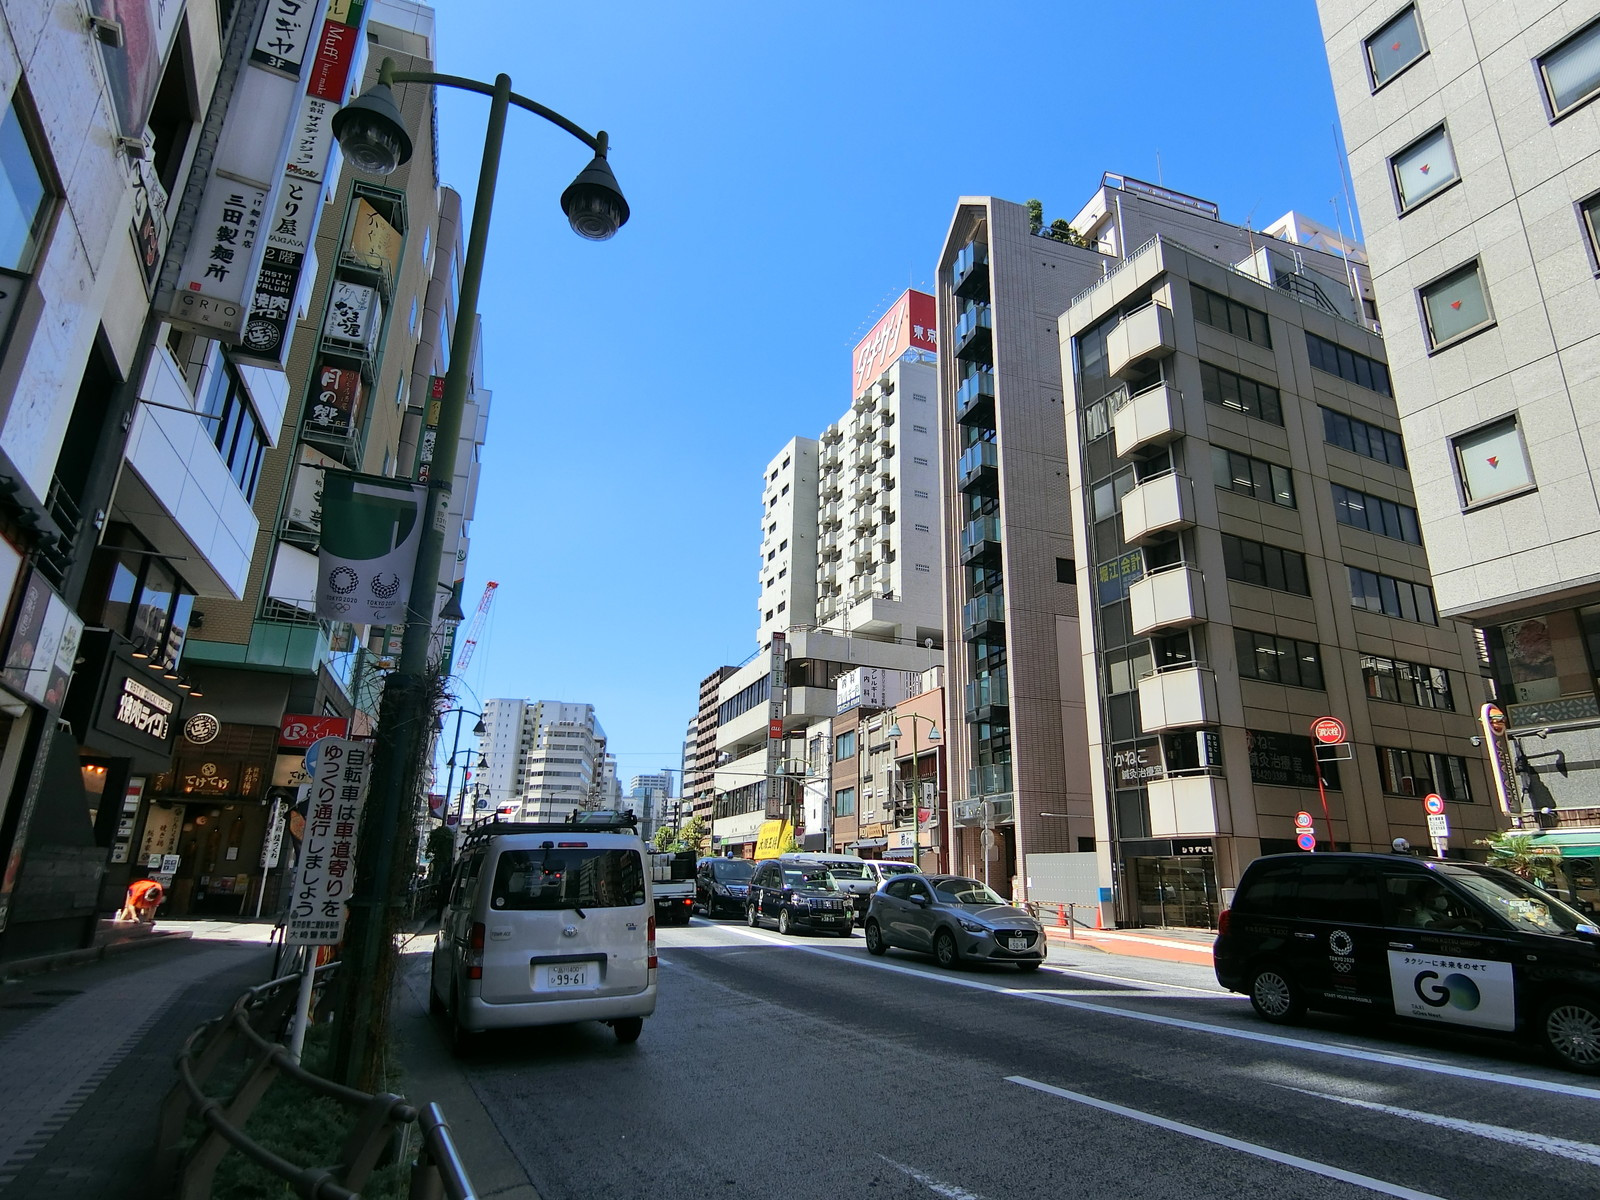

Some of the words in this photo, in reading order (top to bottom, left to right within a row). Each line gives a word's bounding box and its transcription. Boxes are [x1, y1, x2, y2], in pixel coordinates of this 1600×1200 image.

[323, 25, 345, 60] Muff
[267, 56, 286, 69] 3F
[323, 63, 333, 78] hair
[316, 77, 327, 95] make
[275, 183, 304, 237] とり屋
[242, 192, 265, 249] つけ麺専門店
[204, 194, 247, 283] 三田製麺所
[266, 248, 296, 264] 2階
[338, 283, 351, 295] 7F
[183, 295, 236, 317] GRIO
[913, 324, 937, 344] 東京
[327, 594, 342, 602] TOKYO
[343, 596, 358, 604] 2020
[863, 675, 870, 697] 内科
[870, 668, 878, 705] アレルギー科
[117, 693, 164, 737] 焼肉ライク
[1317, 728, 1339, 737] 消火栓
[1113, 749, 1148, 767] かねこ
[185, 774, 231, 789] てけてけ
[1504, 753, 1518, 801] SANDWICH
[1298, 816, 1309, 824] 30
[296, 744, 343, 917] ゆっくり通行しましょう
[320, 749, 365, 918] 自転車は車道寄りを
[289, 930, 339, 940] 大崎警察署
[1404, 957, 1487, 972] タクシーに未来をのせて
[557, 973, 584, 985] 99-61
[1414, 970, 1481, 1012] GO
